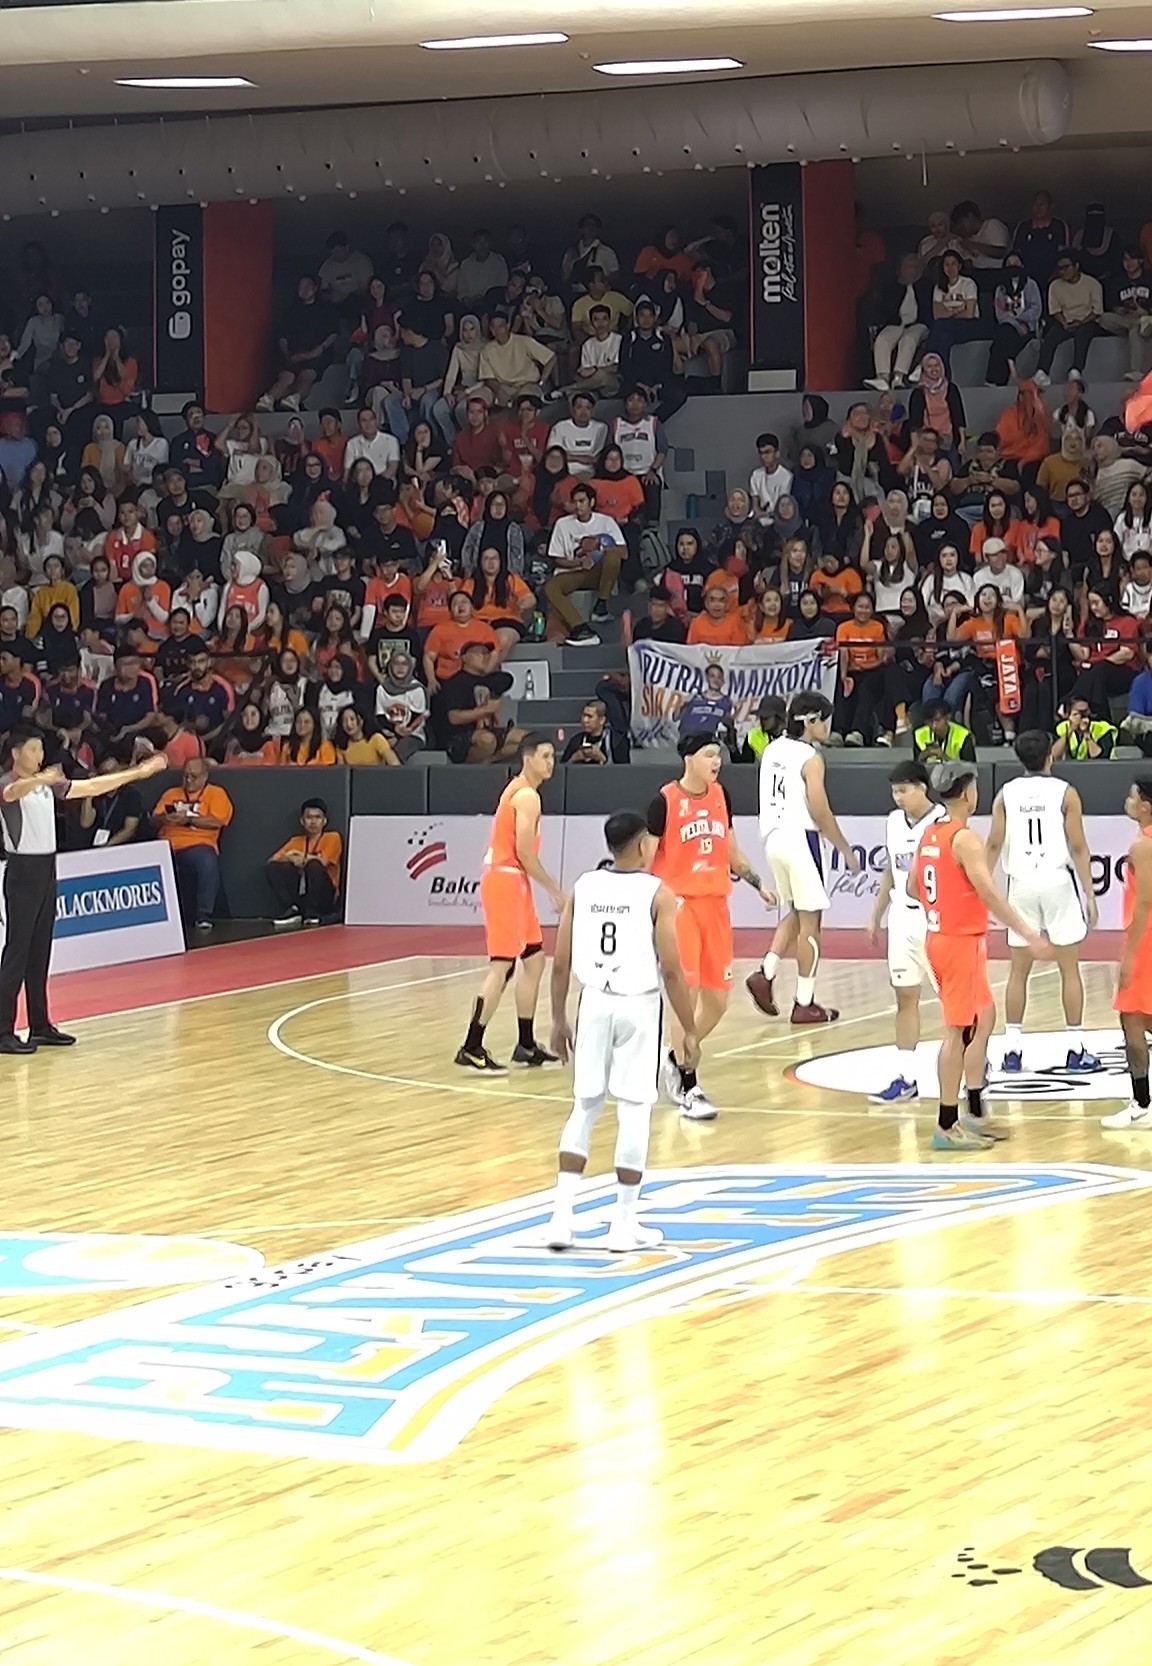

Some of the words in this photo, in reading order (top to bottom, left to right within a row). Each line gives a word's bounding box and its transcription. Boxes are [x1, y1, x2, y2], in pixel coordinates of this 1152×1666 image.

[172, 229, 191, 306] gopay
[760, 203, 781, 303] molten
[642, 652, 704, 697] PUTRA
[728, 656, 823, 699] MAHKOTA
[1001, 653, 1018, 695] JAYA
[771, 773, 786, 800] 14
[1028, 818, 1043, 846] 11
[431, 876, 481, 894] Bakr
[923, 864, 937, 903] 9
[600, 921, 617, 956] 8
